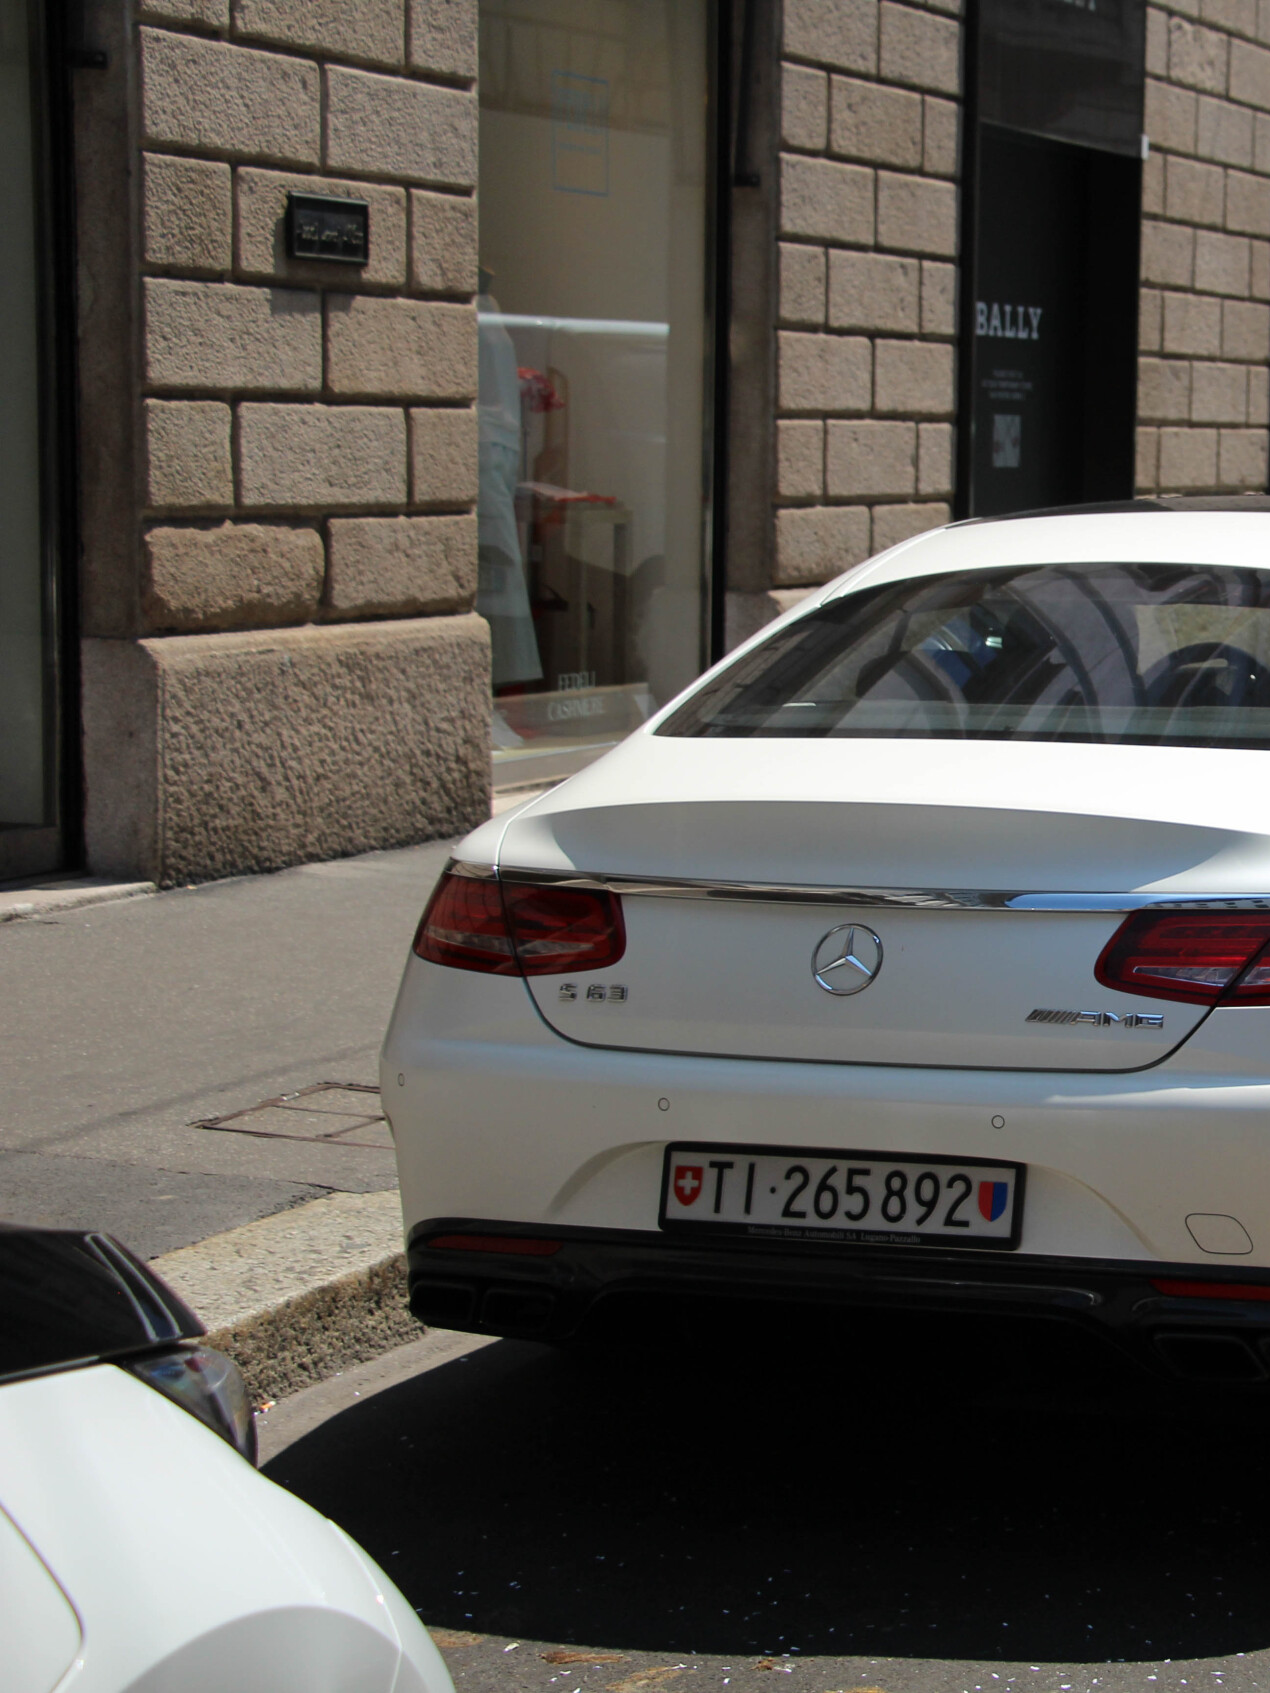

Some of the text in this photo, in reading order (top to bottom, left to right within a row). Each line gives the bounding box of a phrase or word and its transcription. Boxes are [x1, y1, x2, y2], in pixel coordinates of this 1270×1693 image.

[975, 301, 1043, 340] BALLY
[559, 983, 629, 1002] S 63
[1068, 1011, 1164, 1028] AMG
[804, 1229, 844, 1240] Automobili
